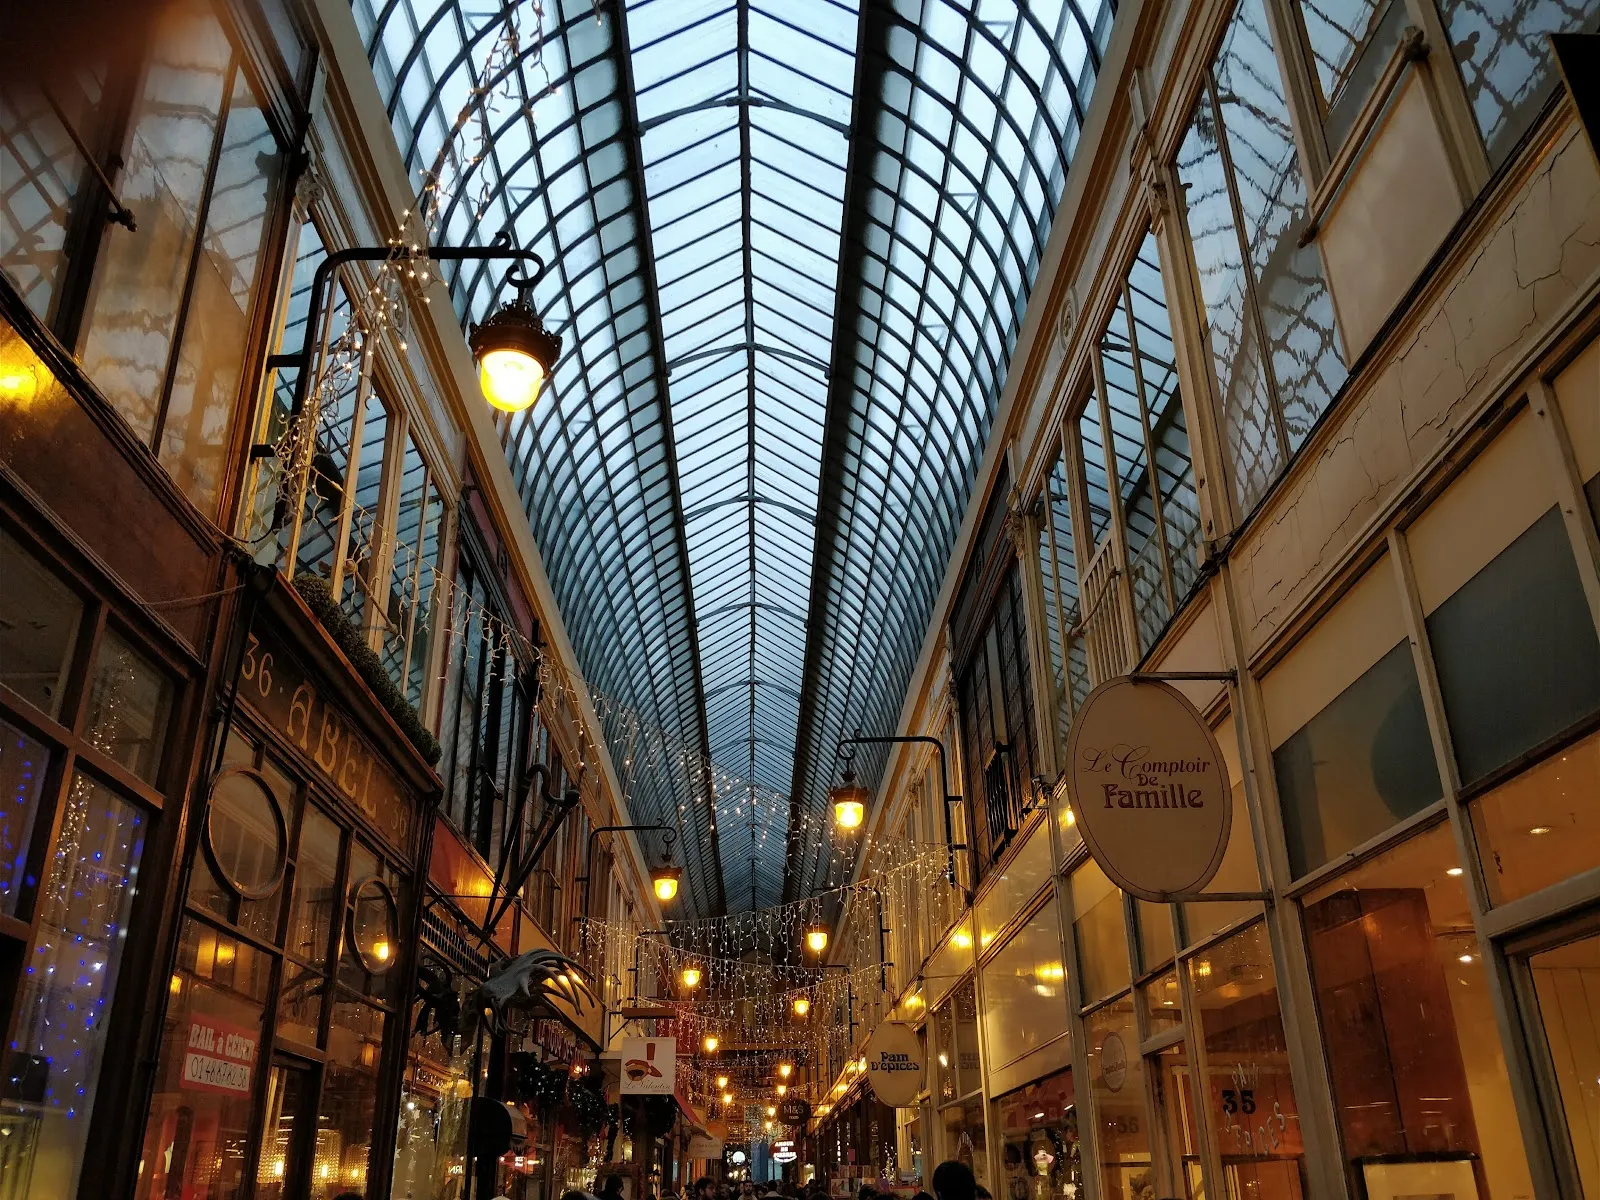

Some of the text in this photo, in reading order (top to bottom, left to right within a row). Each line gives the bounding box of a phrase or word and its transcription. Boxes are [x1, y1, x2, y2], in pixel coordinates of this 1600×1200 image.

[242, 632, 408, 838] 36 ABEL 36
[1081, 743, 1210, 780] Le Comptoir
[1137, 773, 1159, 787] De
[1101, 783, 1204, 809] Famille
[188, 1023, 215, 1053] BAIL
[880, 1051, 909, 1062] Pain
[783, 1104, 804, 1114] M&S
[1221, 1089, 1257, 1115] 35
